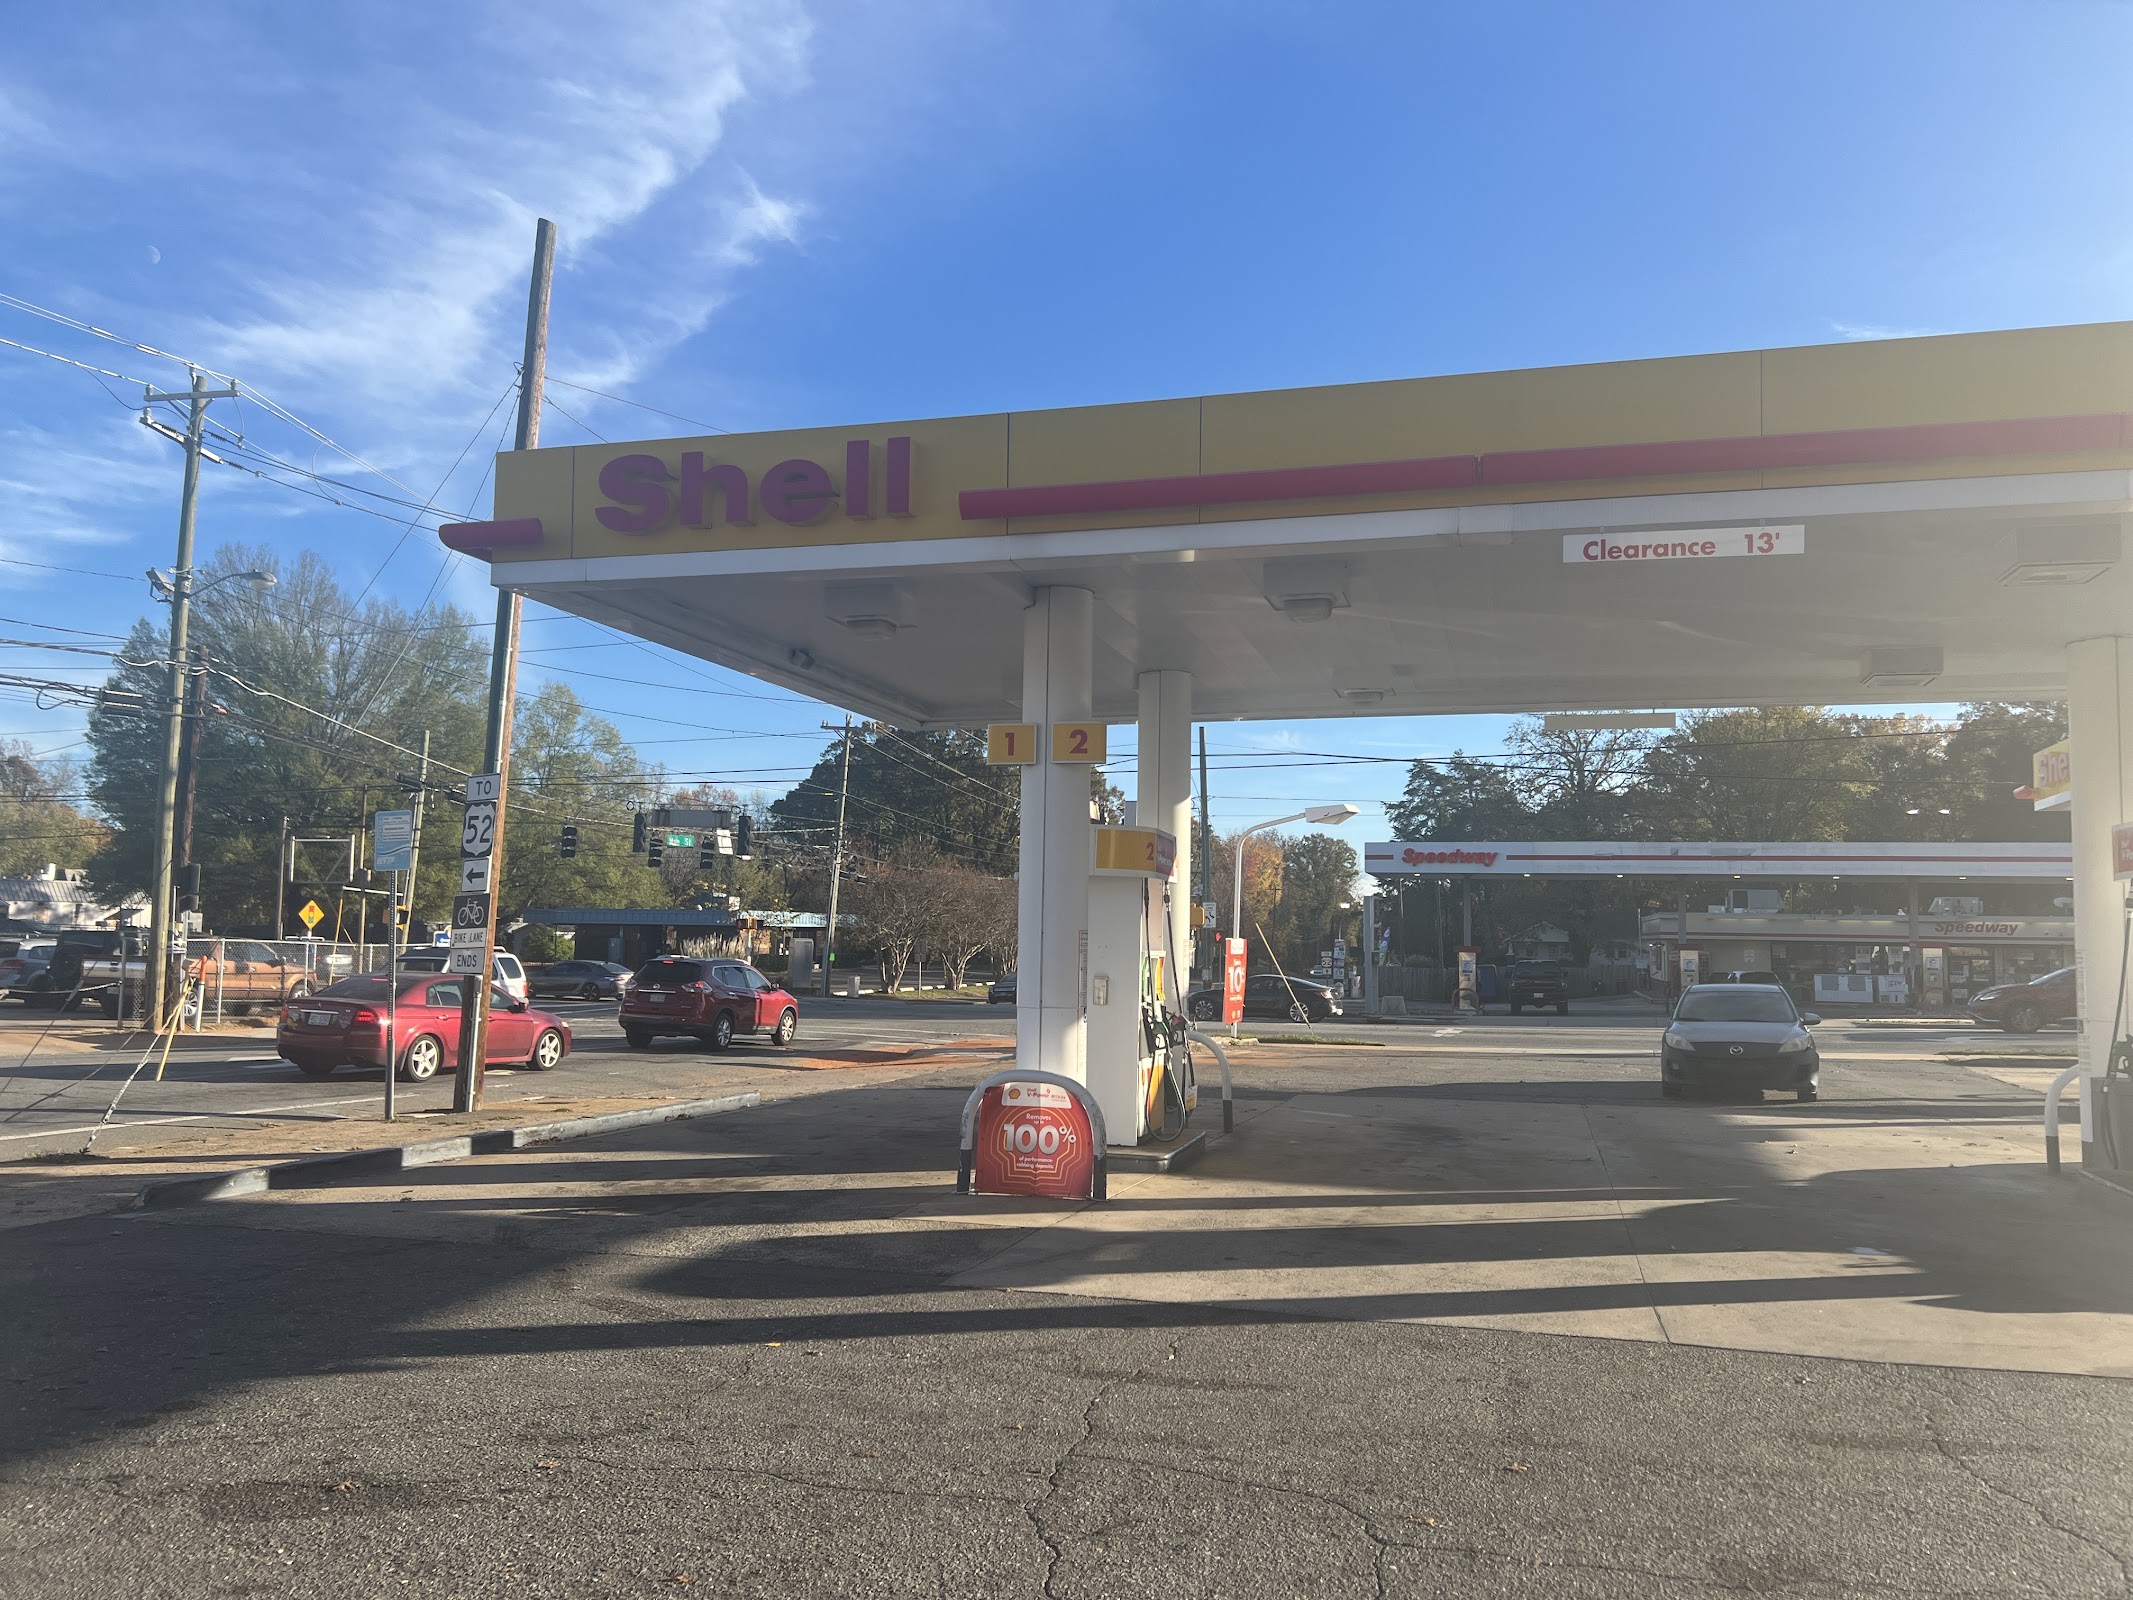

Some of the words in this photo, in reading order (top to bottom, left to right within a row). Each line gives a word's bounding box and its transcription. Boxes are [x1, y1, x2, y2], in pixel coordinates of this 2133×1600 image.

[595, 437, 914, 534] Shell
[1583, 539, 1716, 561] Clearance
[1744, 532, 1780, 554] 13'
[1004, 732, 1015, 757] 1
[1069, 729, 1088, 754] 2
[476, 780, 492, 796] TO
[465, 814, 491, 845] 52
[1146, 842, 1155, 861] 2
[1402, 847, 1498, 867] Speedway
[454, 933, 467, 944] BIKE
[470, 932, 484, 943] LANE
[1934, 921, 2019, 936] Speedway
[456, 954, 477, 968] ENDS
[1322, 958, 1332, 966] 52
[1003, 1123, 1077, 1155] 100%
